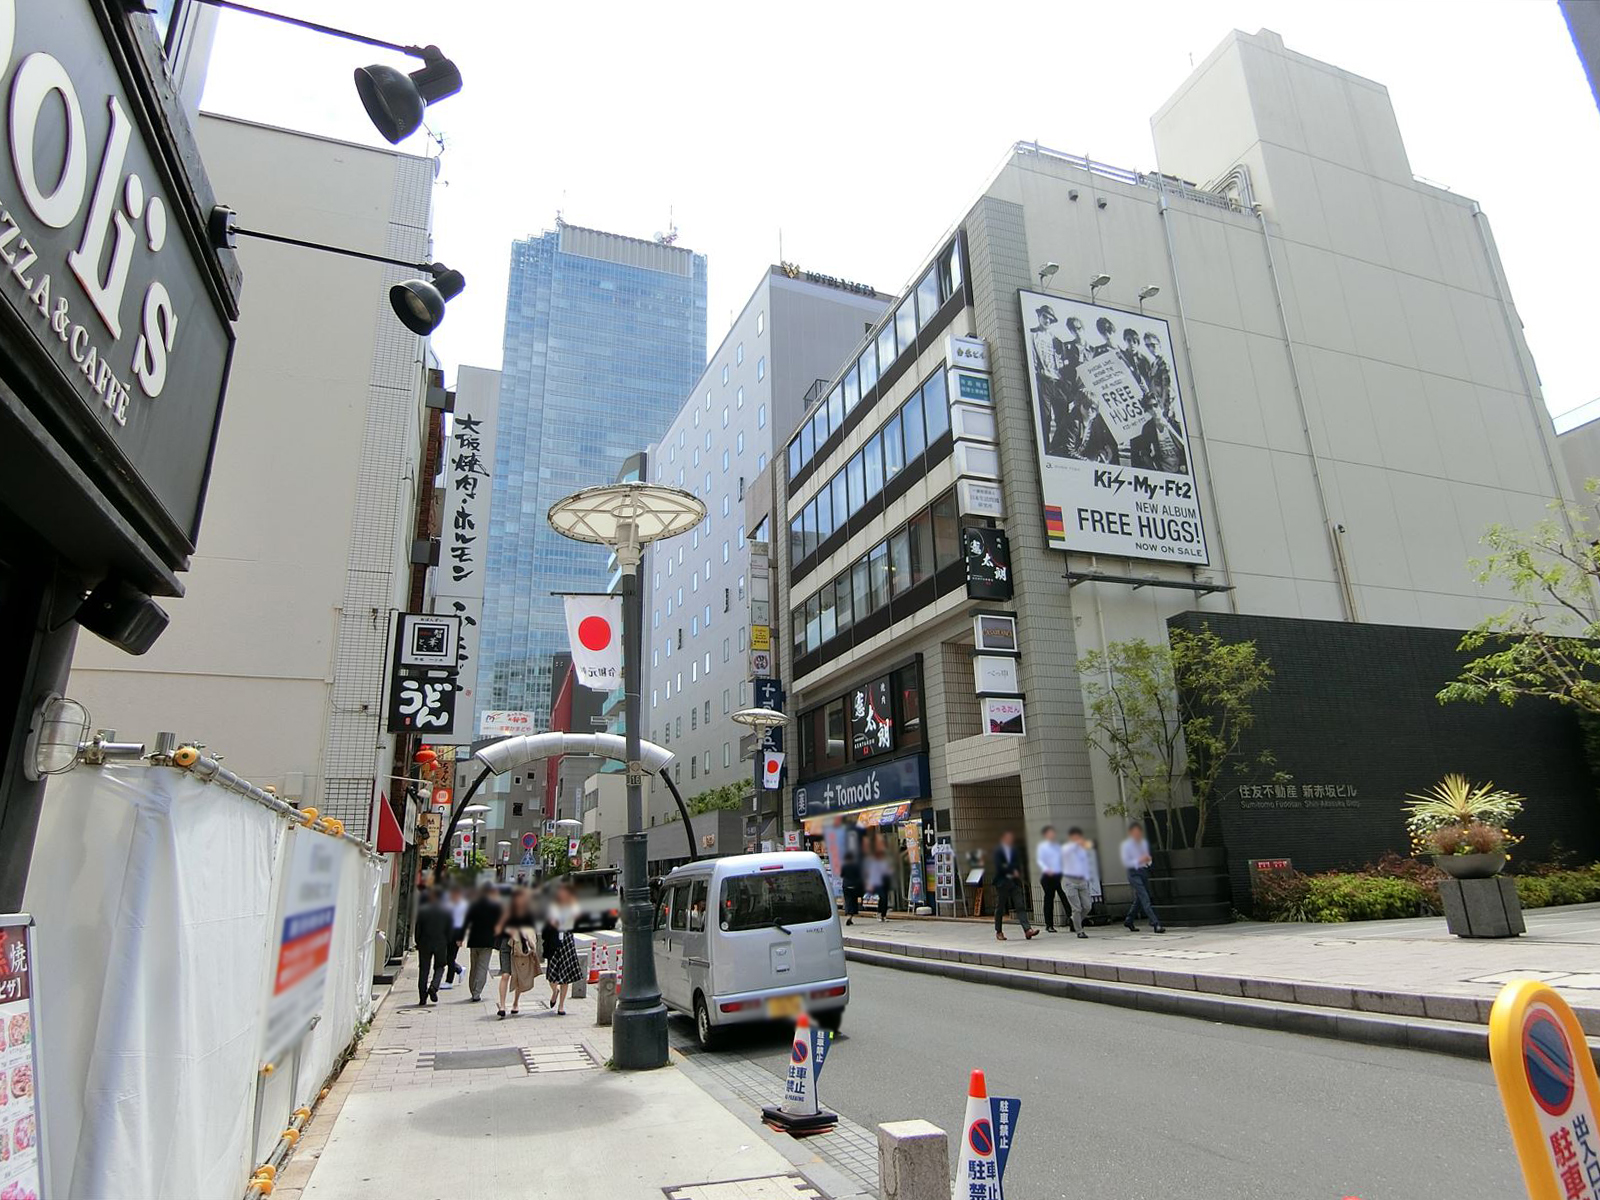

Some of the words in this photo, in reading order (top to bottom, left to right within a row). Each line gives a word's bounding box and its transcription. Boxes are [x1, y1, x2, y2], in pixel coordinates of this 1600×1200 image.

[0, 0, 178, 398] oli's
[52, 297, 69, 342] &
[1102, 385, 1135, 409] FREE
[452, 413, 490, 582] 大阪焼肉・ホルモン
[1135, 501, 1158, 514] NEW
[1162, 504, 1197, 519] ALBUM
[1077, 508, 1133, 536] FREE
[1137, 515, 1201, 544] HUGS!
[1135, 542, 1158, 552] NOW
[1161, 545, 1175, 554] ON
[1178, 547, 1203, 557] SALE
[399, 680, 453, 728] うどん
[835, 771, 881, 806] Tomod's
[1239, 785, 1299, 799] 住友不動産
[1302, 785, 1358, 798] 新赤坂ビル
[968, 1160, 997, 1180] 駐車
[1550, 1126, 1592, 1200] 駐車
